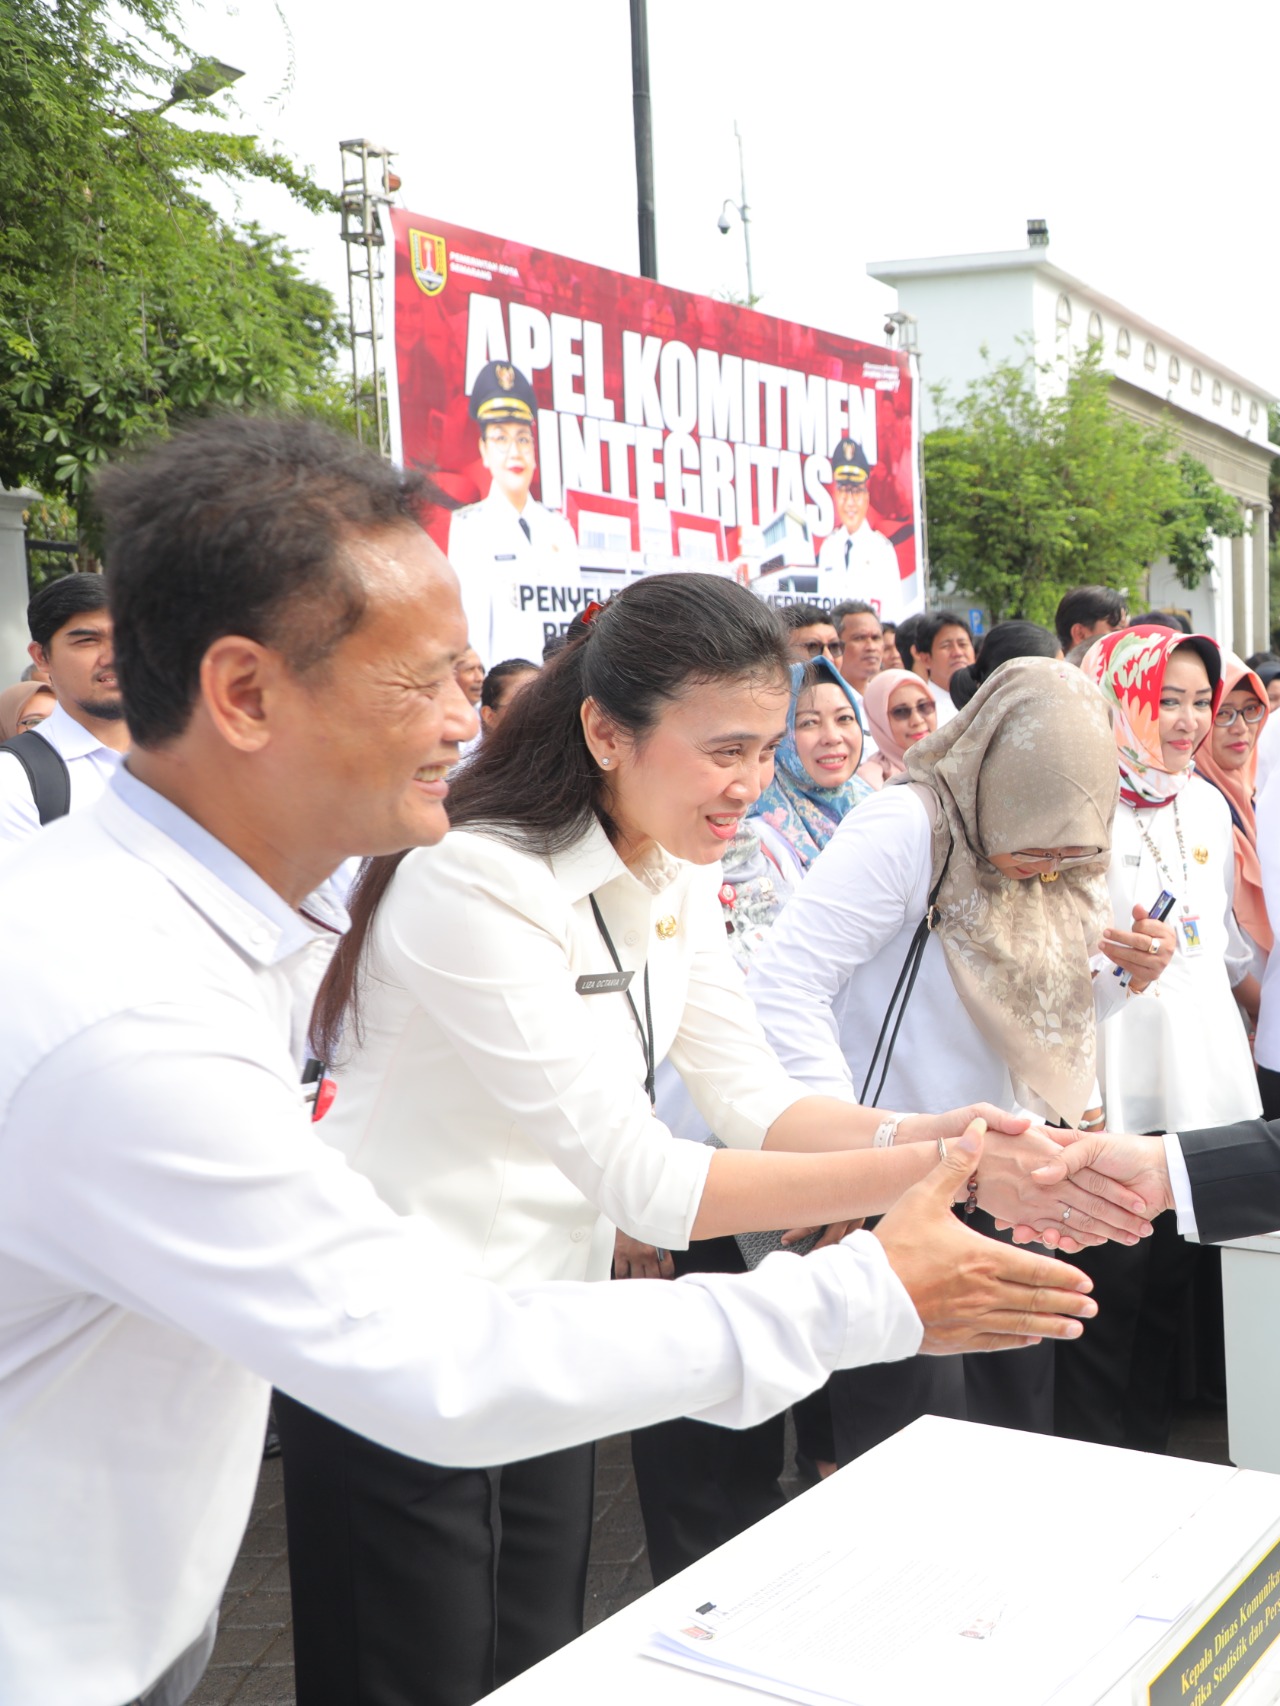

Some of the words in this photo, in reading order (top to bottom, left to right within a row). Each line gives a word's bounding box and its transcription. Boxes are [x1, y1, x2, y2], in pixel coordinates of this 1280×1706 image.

[498, 263, 519, 278] KOTA
[465, 292, 615, 421] APEL
[622, 330, 877, 466] KOMITMEN
[537, 408, 835, 537] INTEGRITAS
[581, 981, 595, 989] LIZA
[596, 978, 620, 988] OCTAVIA
[1180, 1647, 1213, 1696] Kepala
[1214, 1619, 1239, 1657] Dinas
[1213, 1636, 1248, 1689] Statistik
[1248, 1619, 1264, 1646] dan
